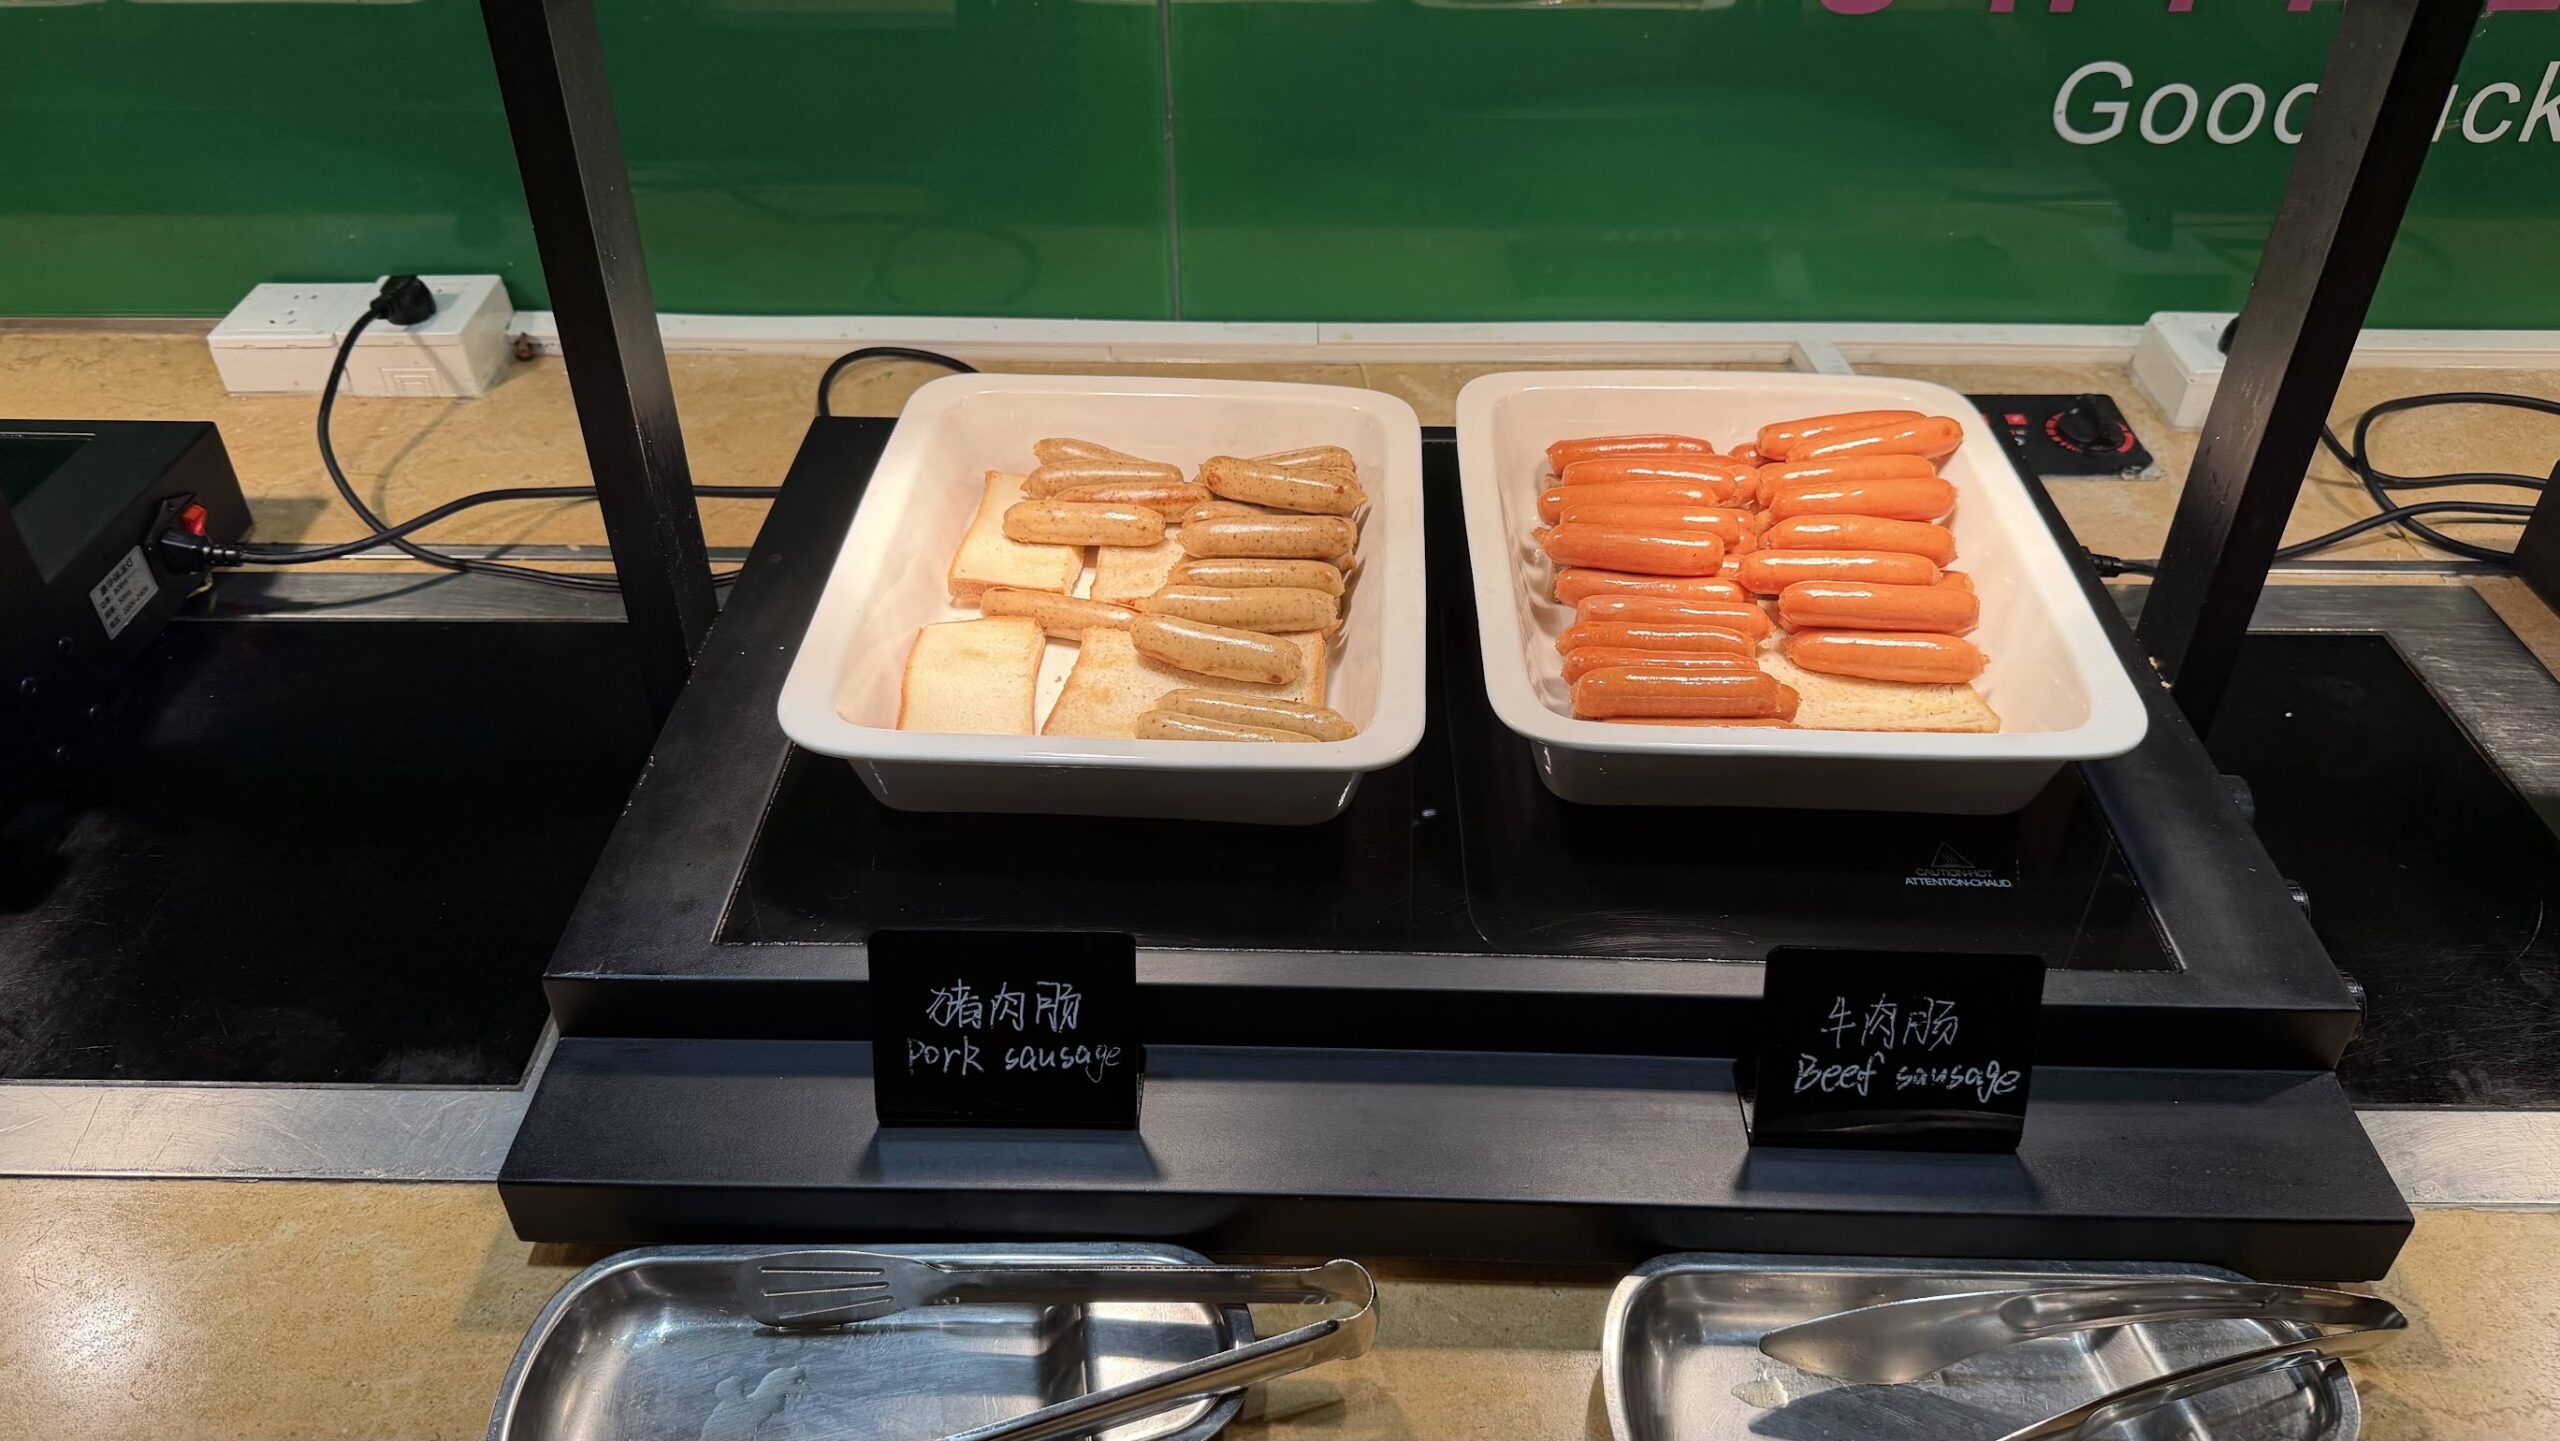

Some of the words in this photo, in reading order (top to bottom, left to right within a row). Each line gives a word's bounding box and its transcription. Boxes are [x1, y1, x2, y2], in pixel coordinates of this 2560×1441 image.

[1819, 992, 1959, 1051] 牛肉肠
[1004, 1043, 1122, 1084] sausage
[1794, 1051, 1886, 1097] Beef
[1895, 1059, 2021, 1104] sausage
